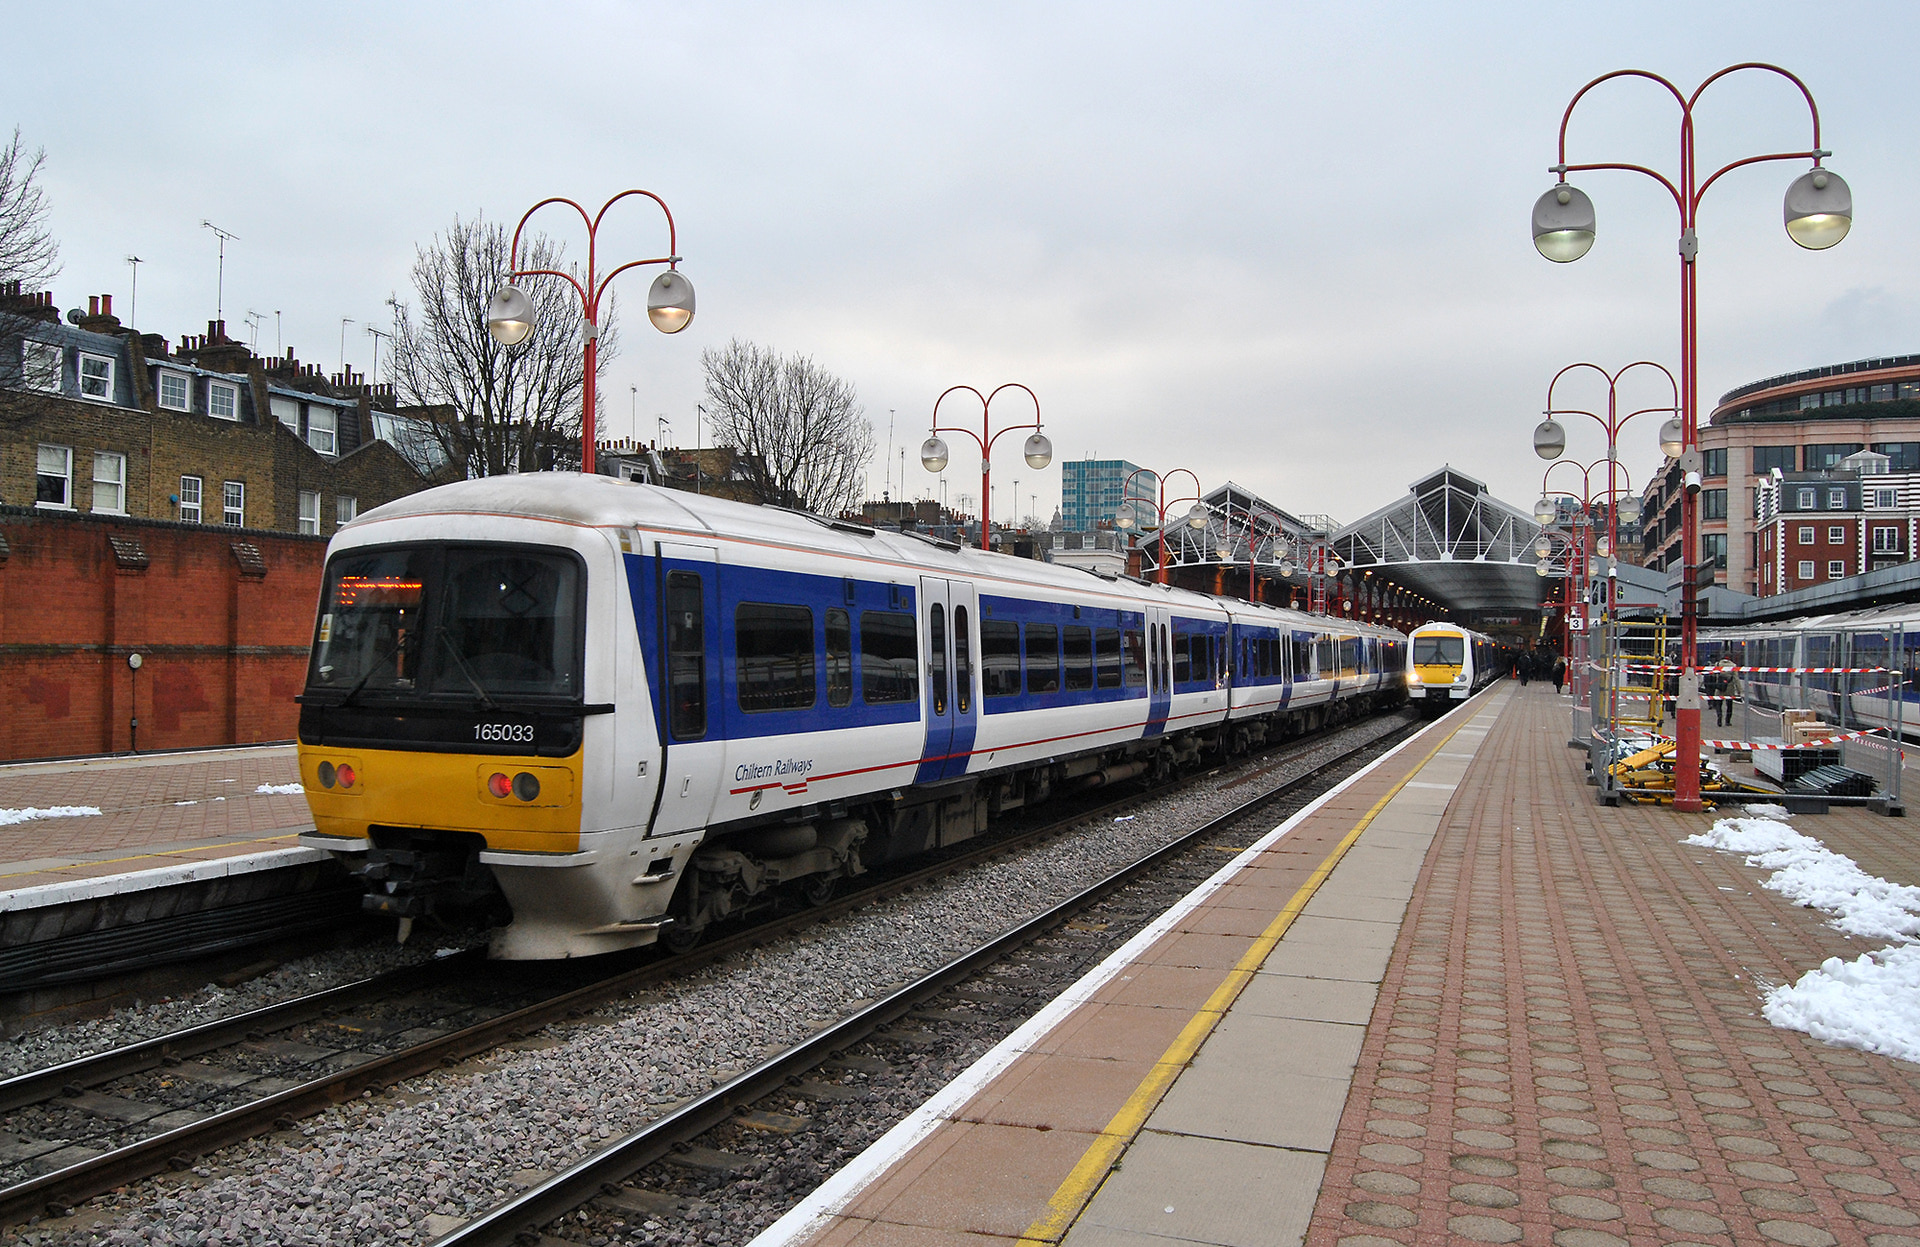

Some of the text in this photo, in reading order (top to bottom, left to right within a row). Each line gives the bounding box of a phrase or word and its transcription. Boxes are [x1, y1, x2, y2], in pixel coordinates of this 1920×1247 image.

[1572, 619, 1580, 629] 3
[473, 723, 535, 743] 165033
[735, 758, 813, 781] Chiltern Railways
